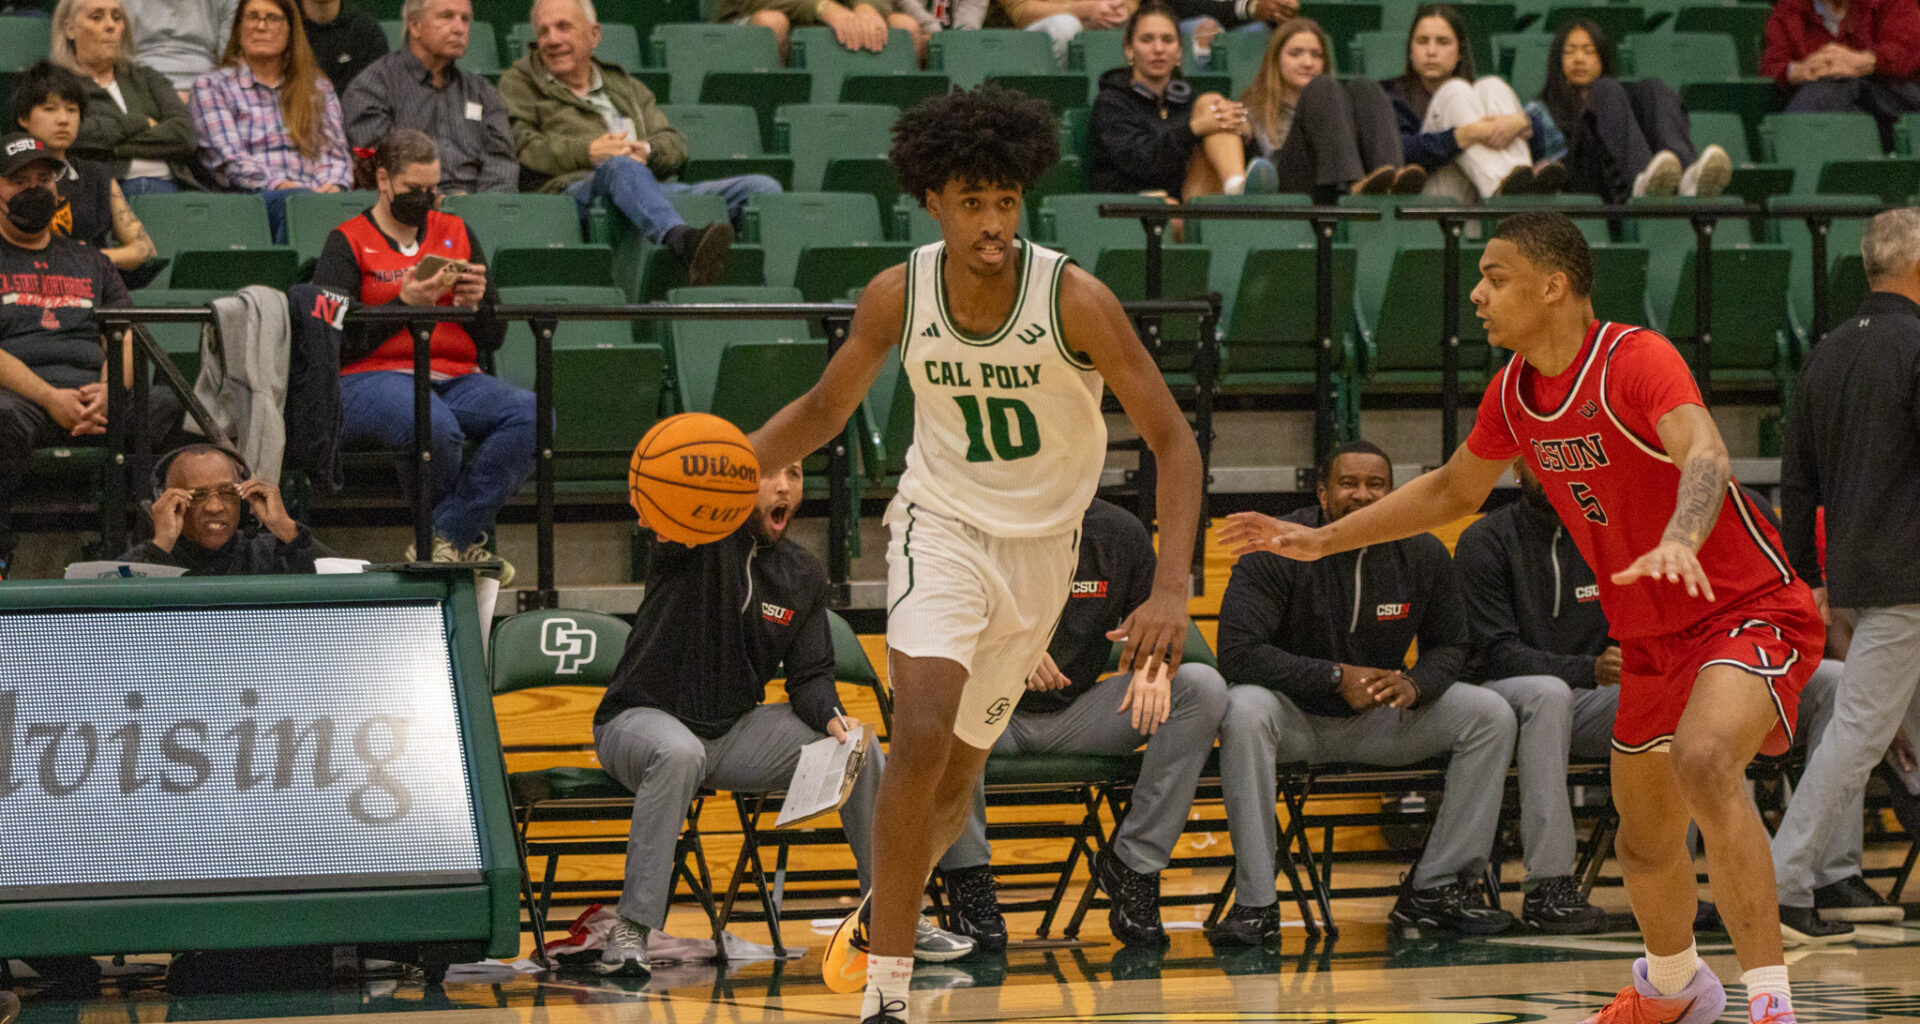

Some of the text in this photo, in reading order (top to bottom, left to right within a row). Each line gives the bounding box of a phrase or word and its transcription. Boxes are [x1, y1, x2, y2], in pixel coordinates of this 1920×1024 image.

[924, 360, 1042, 389] CAL POLY
[952, 395, 1041, 463] 10
[1530, 433, 1611, 472] CSUN
[680, 454, 757, 484] Wilson
[1567, 481, 1609, 527] 5
[1071, 580, 1109, 594] CSUN
[1575, 584, 1600, 599] CSU
[761, 602, 795, 622] CSUN
[1376, 602, 1411, 617] CSUN
